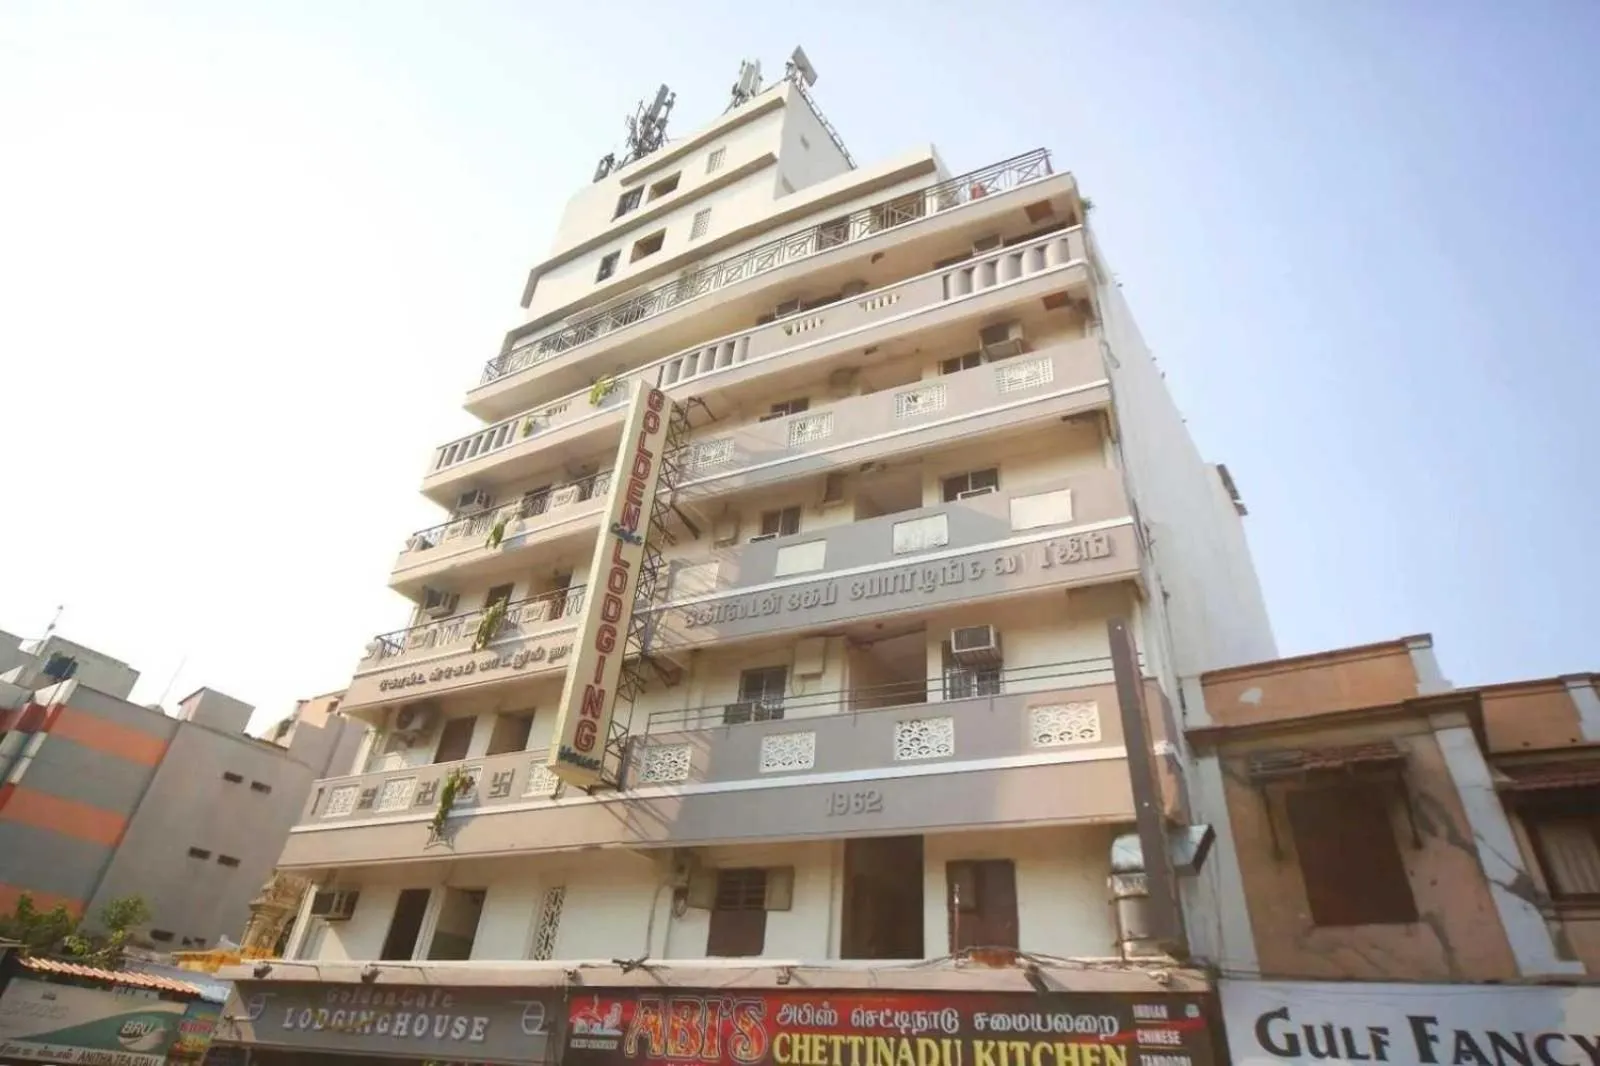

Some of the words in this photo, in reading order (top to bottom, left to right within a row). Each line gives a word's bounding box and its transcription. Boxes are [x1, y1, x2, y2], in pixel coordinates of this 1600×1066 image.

[621, 388, 665, 533] GOLDEN
[574, 537, 631, 753] LODGING
[826, 790, 883, 817] 1962
[121, 1020, 153, 1036] BRU
[624, 994, 768, 1063] ABI'S
[851, 1006, 959, 1035] செட்டிநாடு
[773, 1032, 962, 1066] CHETTINADU
[972, 1039, 1128, 1066] KITCHEN
[1136, 1030, 1182, 1045] CHINESE
